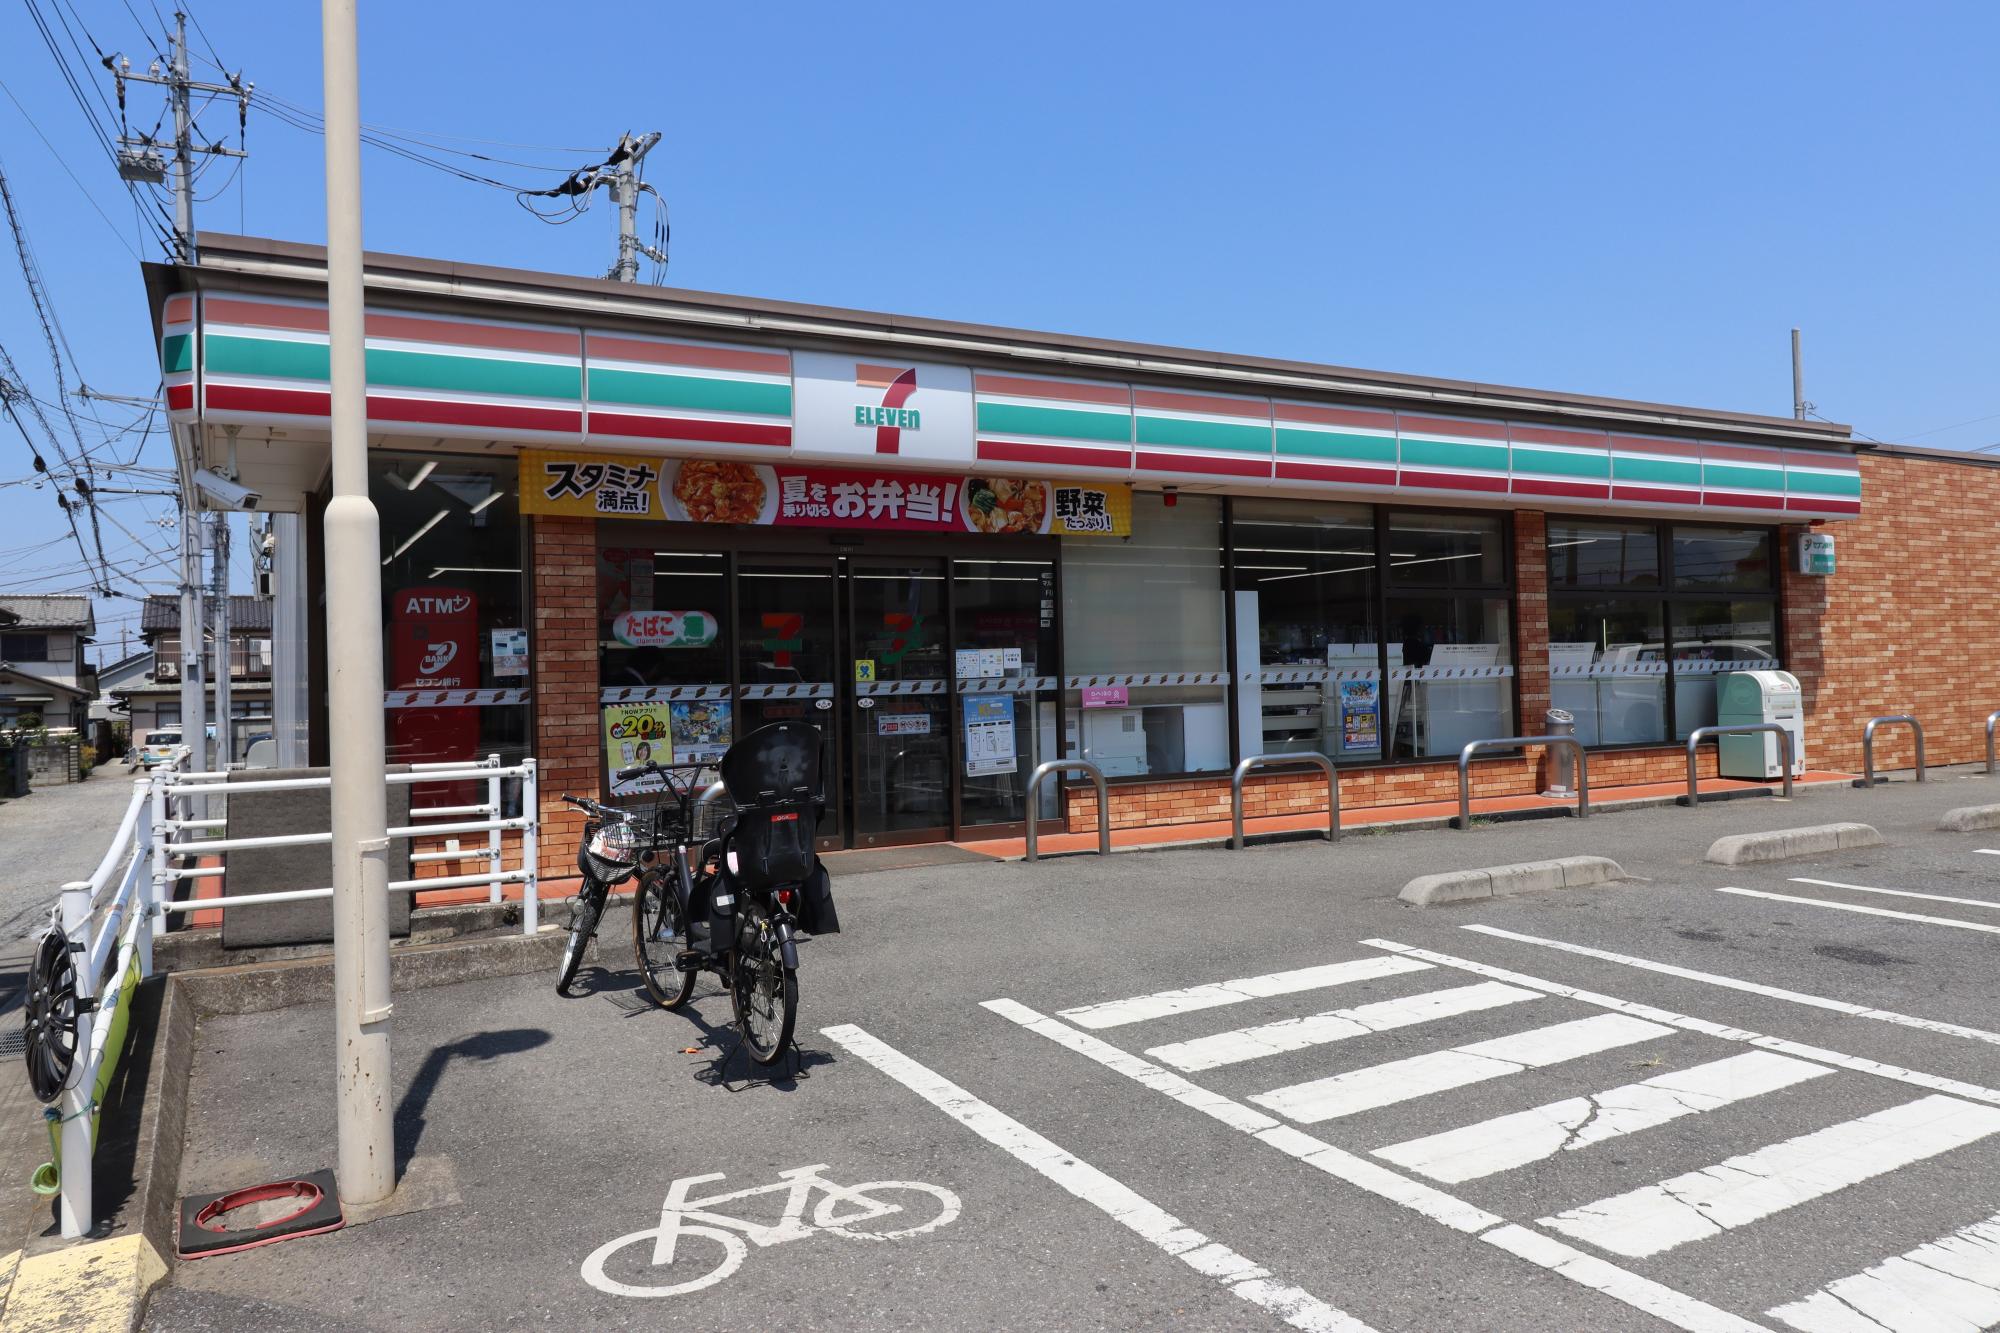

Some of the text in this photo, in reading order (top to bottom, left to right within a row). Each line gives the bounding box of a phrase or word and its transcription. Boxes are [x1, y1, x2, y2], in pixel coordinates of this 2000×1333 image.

[547, 463, 655, 498] スタミナ
[781, 475, 827, 504] 夏を
[598, 490, 648, 512] 満点!
[783, 503, 831, 518] 乗り切る
[832, 479, 958, 523] お弁当!
[1055, 488, 1106, 517] 野菜
[1065, 515, 1111, 530] たっぷり!
[626, 615, 675, 638] たばこ
[415, 677, 462, 687] セブン銀行
